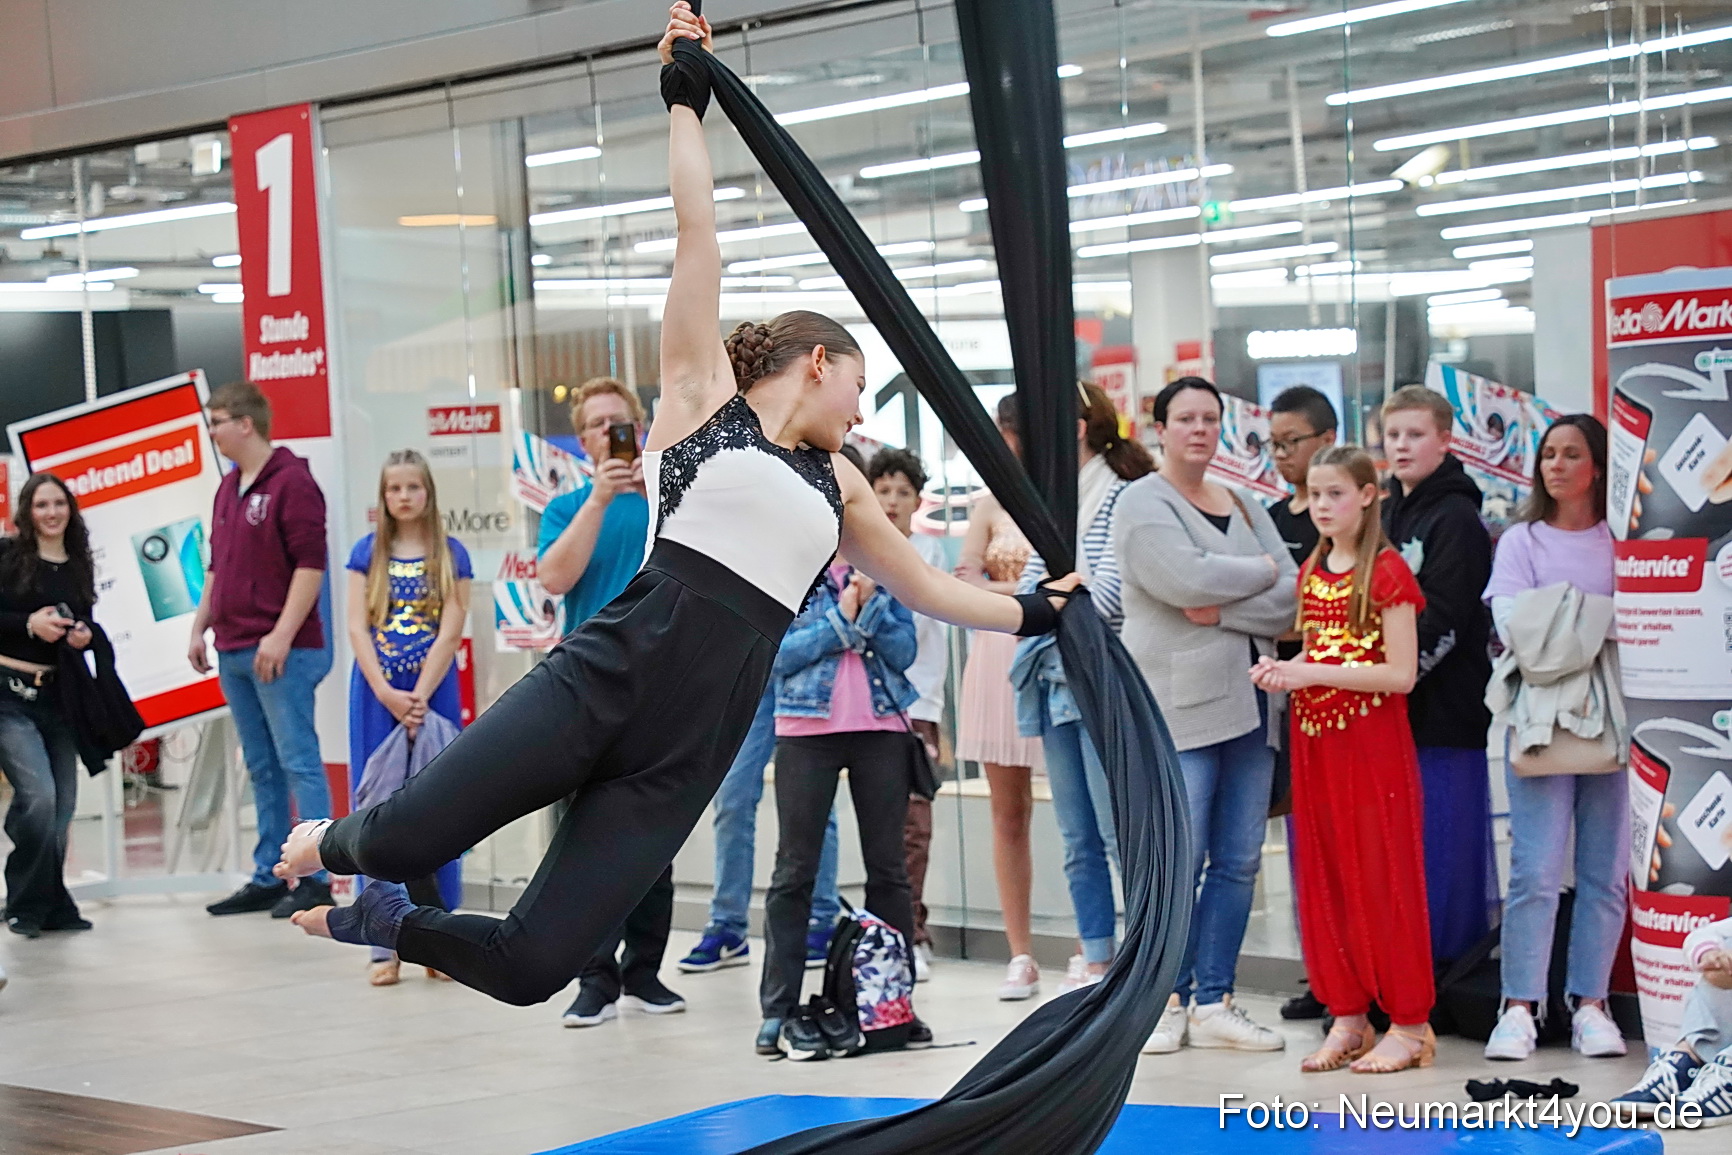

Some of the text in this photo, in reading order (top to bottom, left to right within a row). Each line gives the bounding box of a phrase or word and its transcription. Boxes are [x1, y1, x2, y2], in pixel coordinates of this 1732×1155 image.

[255, 133, 293, 297] 1
[259, 310, 309, 344] Stunde
[64, 438, 195, 496] eekend Deal
[497, 553, 537, 579] Med
